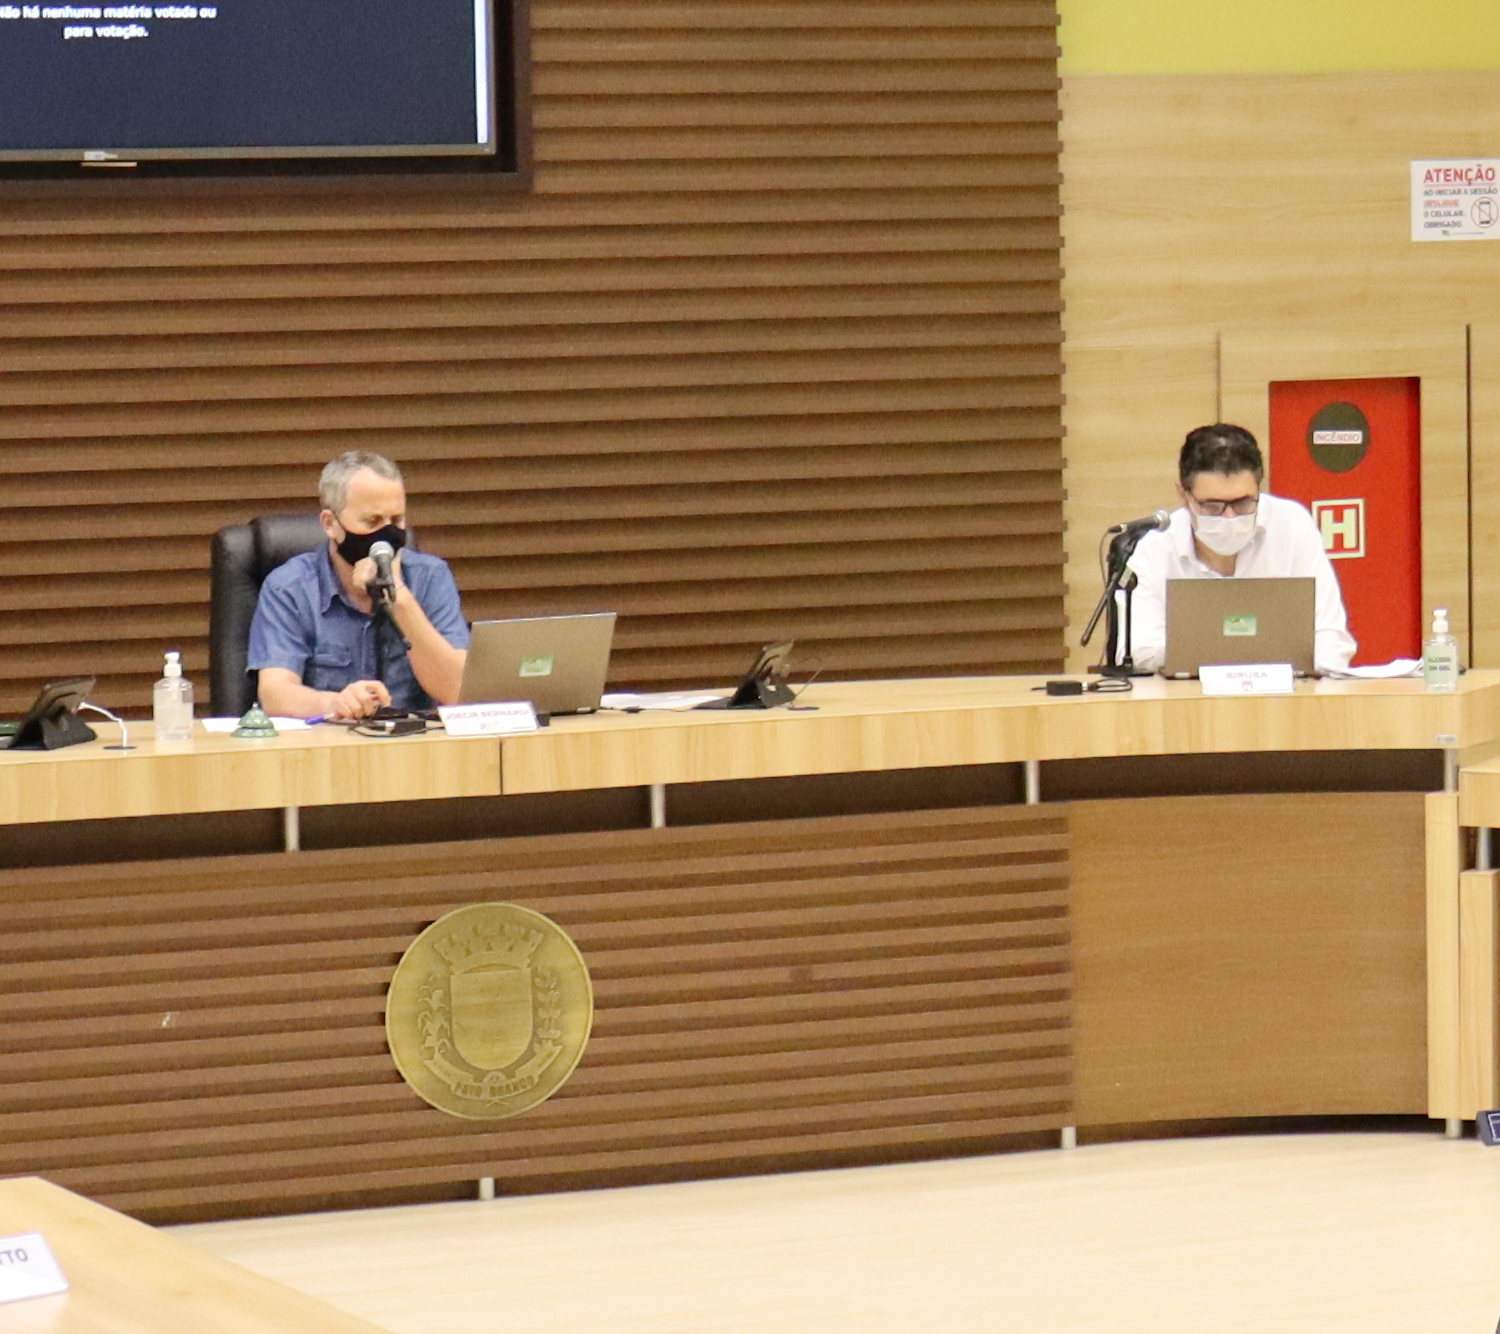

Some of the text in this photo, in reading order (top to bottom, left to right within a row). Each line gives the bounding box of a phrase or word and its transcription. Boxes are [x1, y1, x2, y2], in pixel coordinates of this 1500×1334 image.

[22, 5, 40, 18] há
[42, 5, 102, 18] nenhuma
[103, 4, 153, 18] matéria
[154, 4, 198, 18] votada
[199, 6, 217, 18] ou
[64, 23, 149, 39] para votação.
[1423, 164, 1496, 185] ATENÇÃO
[1314, 430, 1361, 443] INCÊNDIO
[1320, 508, 1357, 550] H
[445, 712, 479, 721] JOECIR
